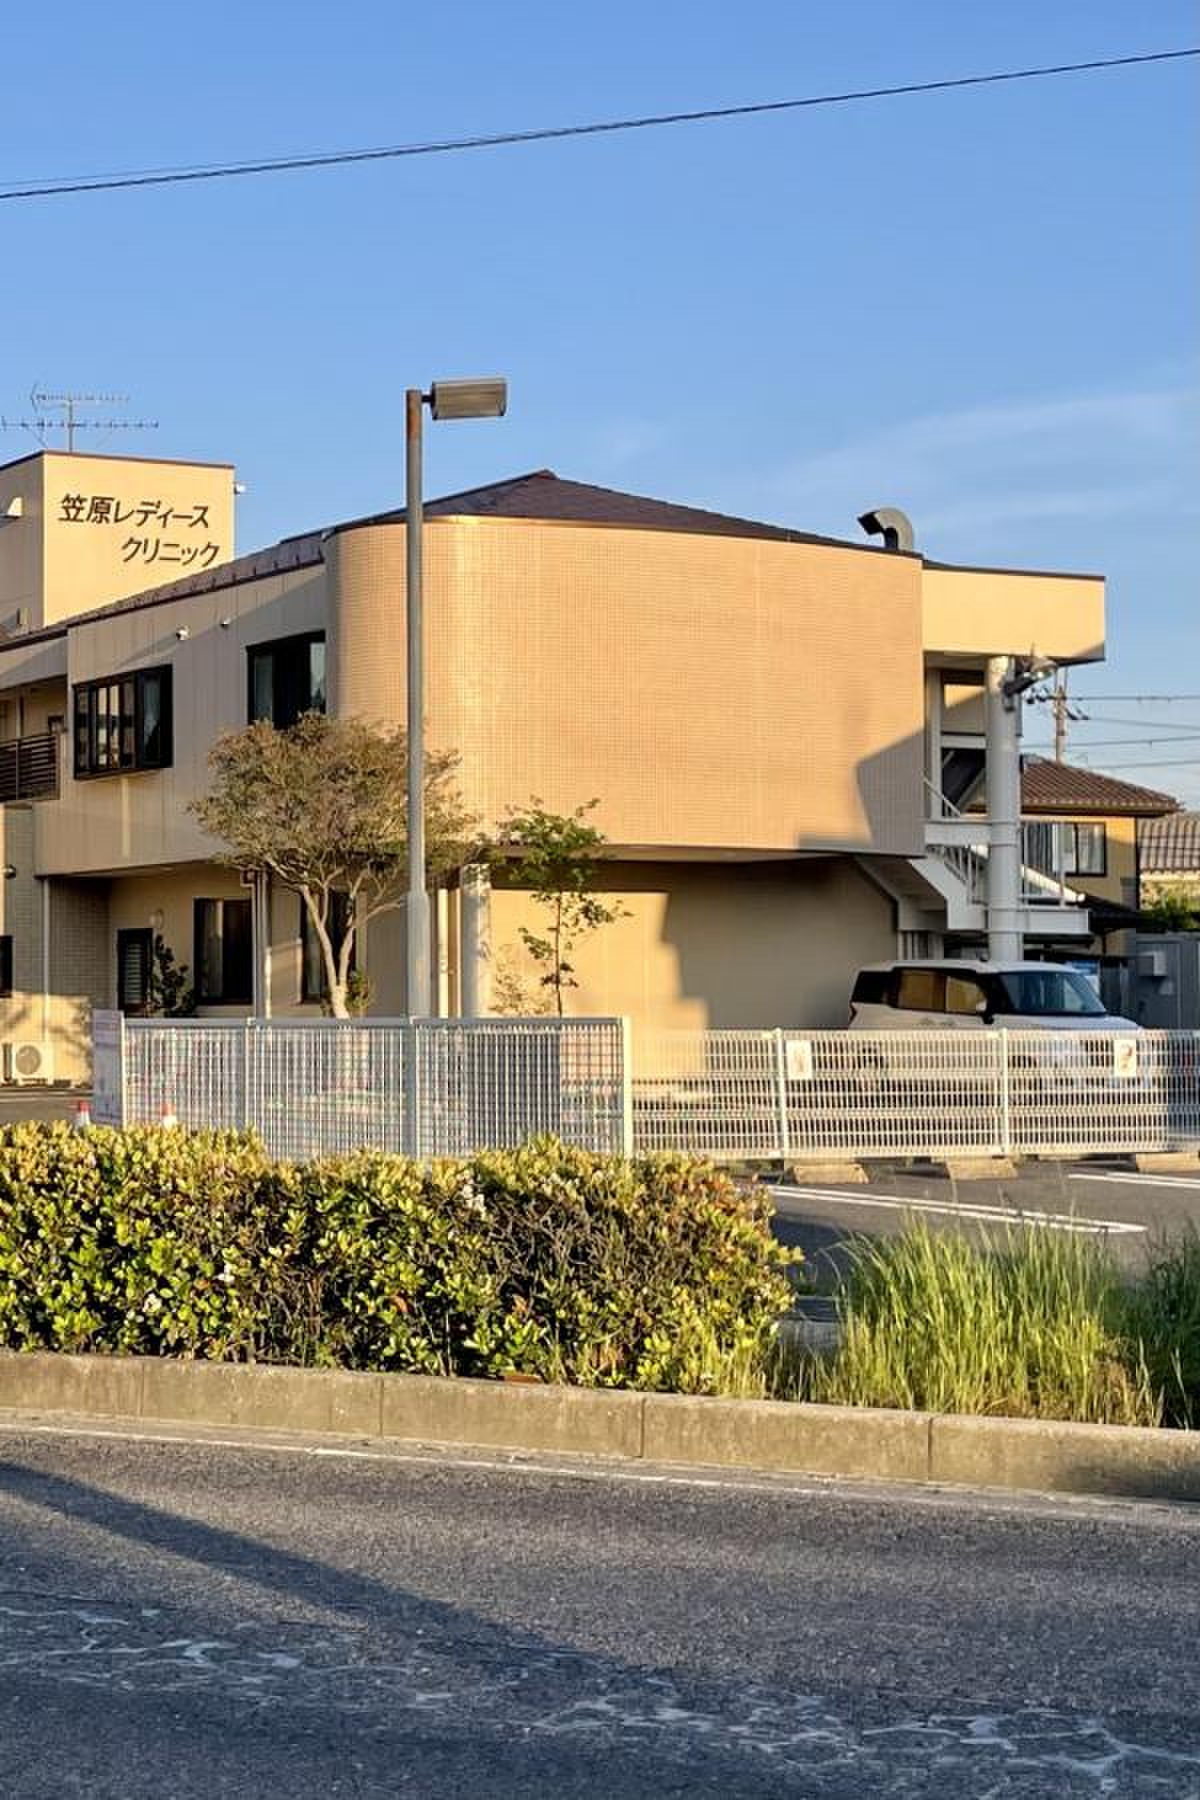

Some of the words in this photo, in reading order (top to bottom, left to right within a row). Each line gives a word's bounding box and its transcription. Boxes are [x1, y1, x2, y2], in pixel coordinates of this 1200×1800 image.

[58, 493, 210, 529] 笠原レディース
[121, 536, 221, 568] クリニック
